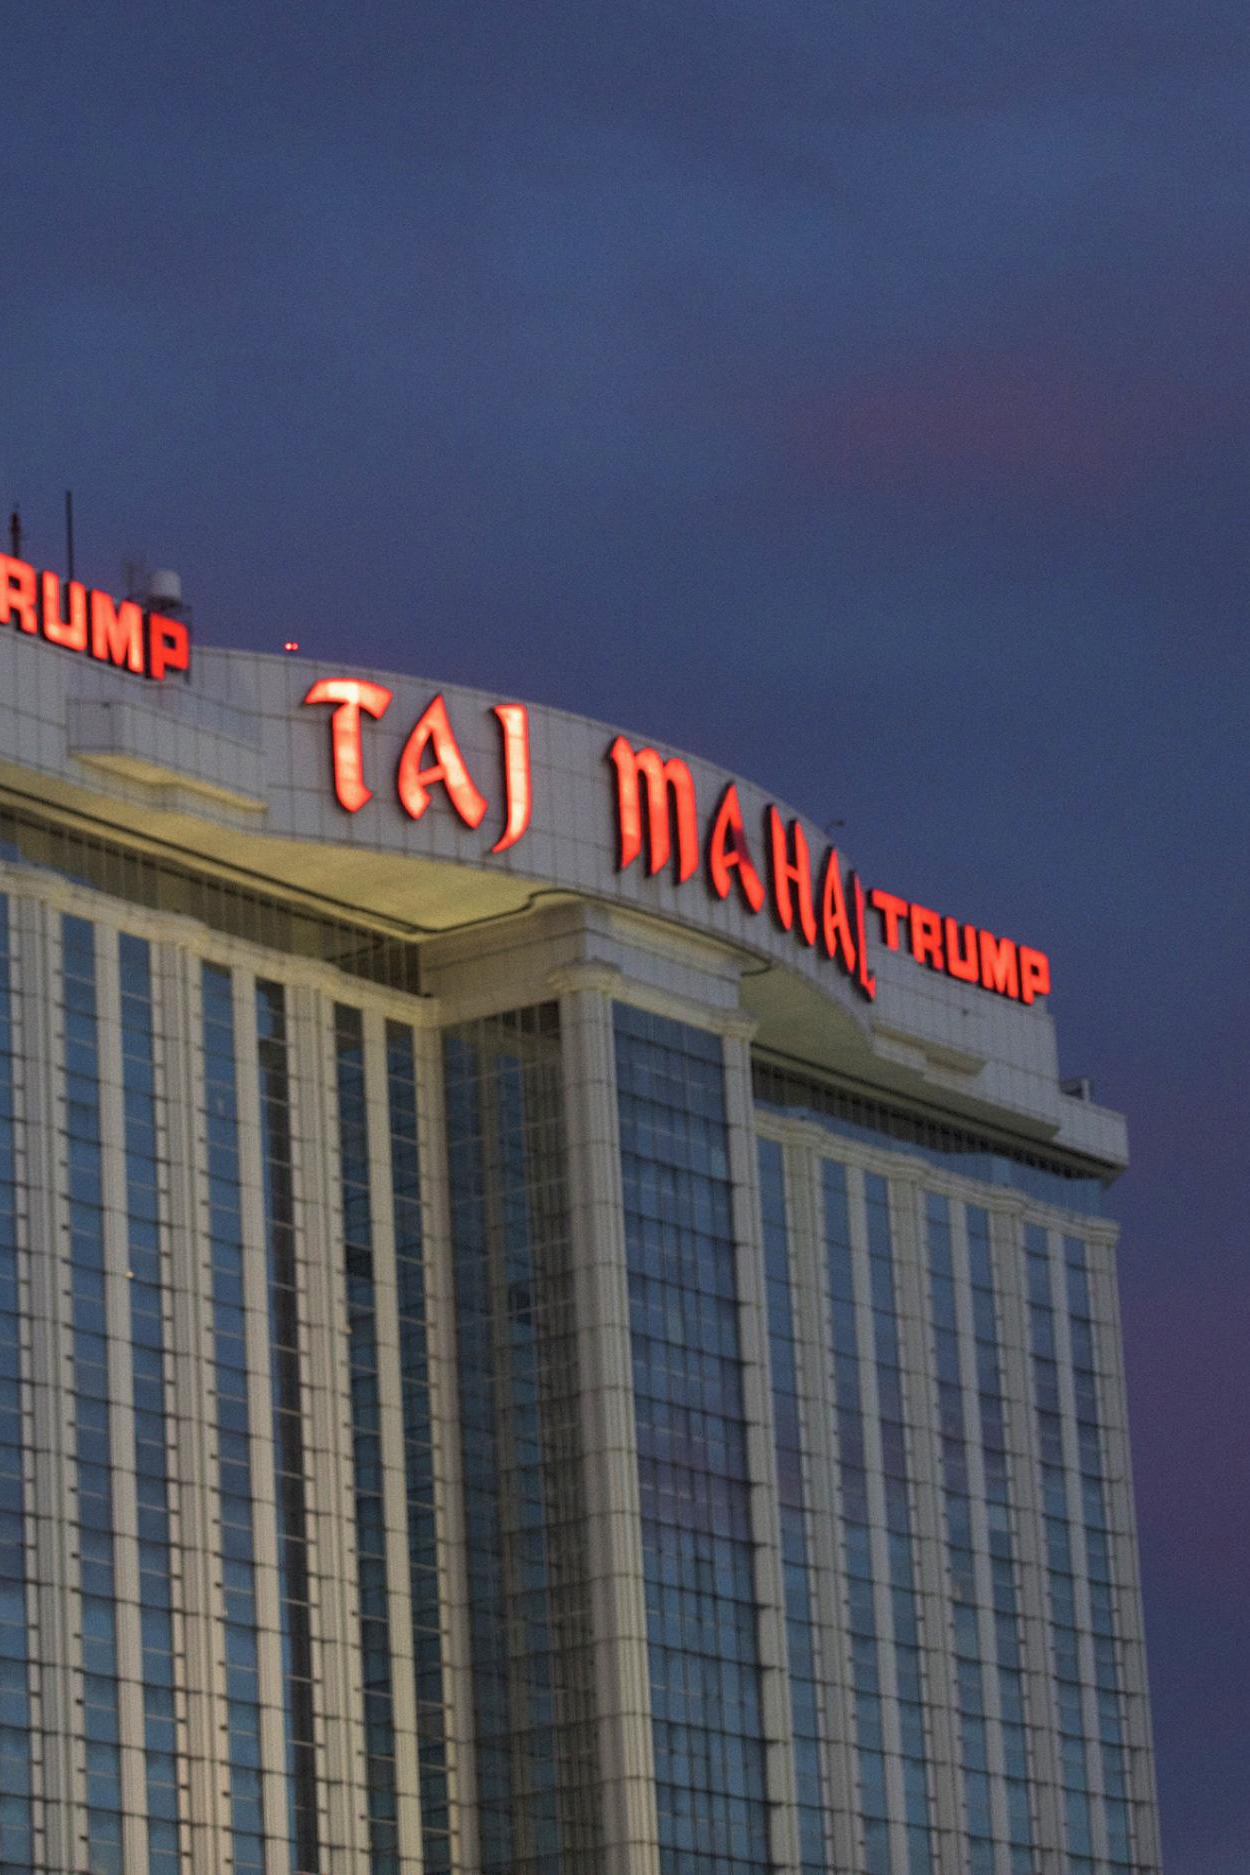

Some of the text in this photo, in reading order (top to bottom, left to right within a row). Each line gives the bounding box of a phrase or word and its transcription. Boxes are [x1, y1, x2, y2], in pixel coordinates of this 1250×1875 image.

[305, 677, 877, 1001] TAJ MAHAL
[871, 889, 1051, 1005] TRUMP
